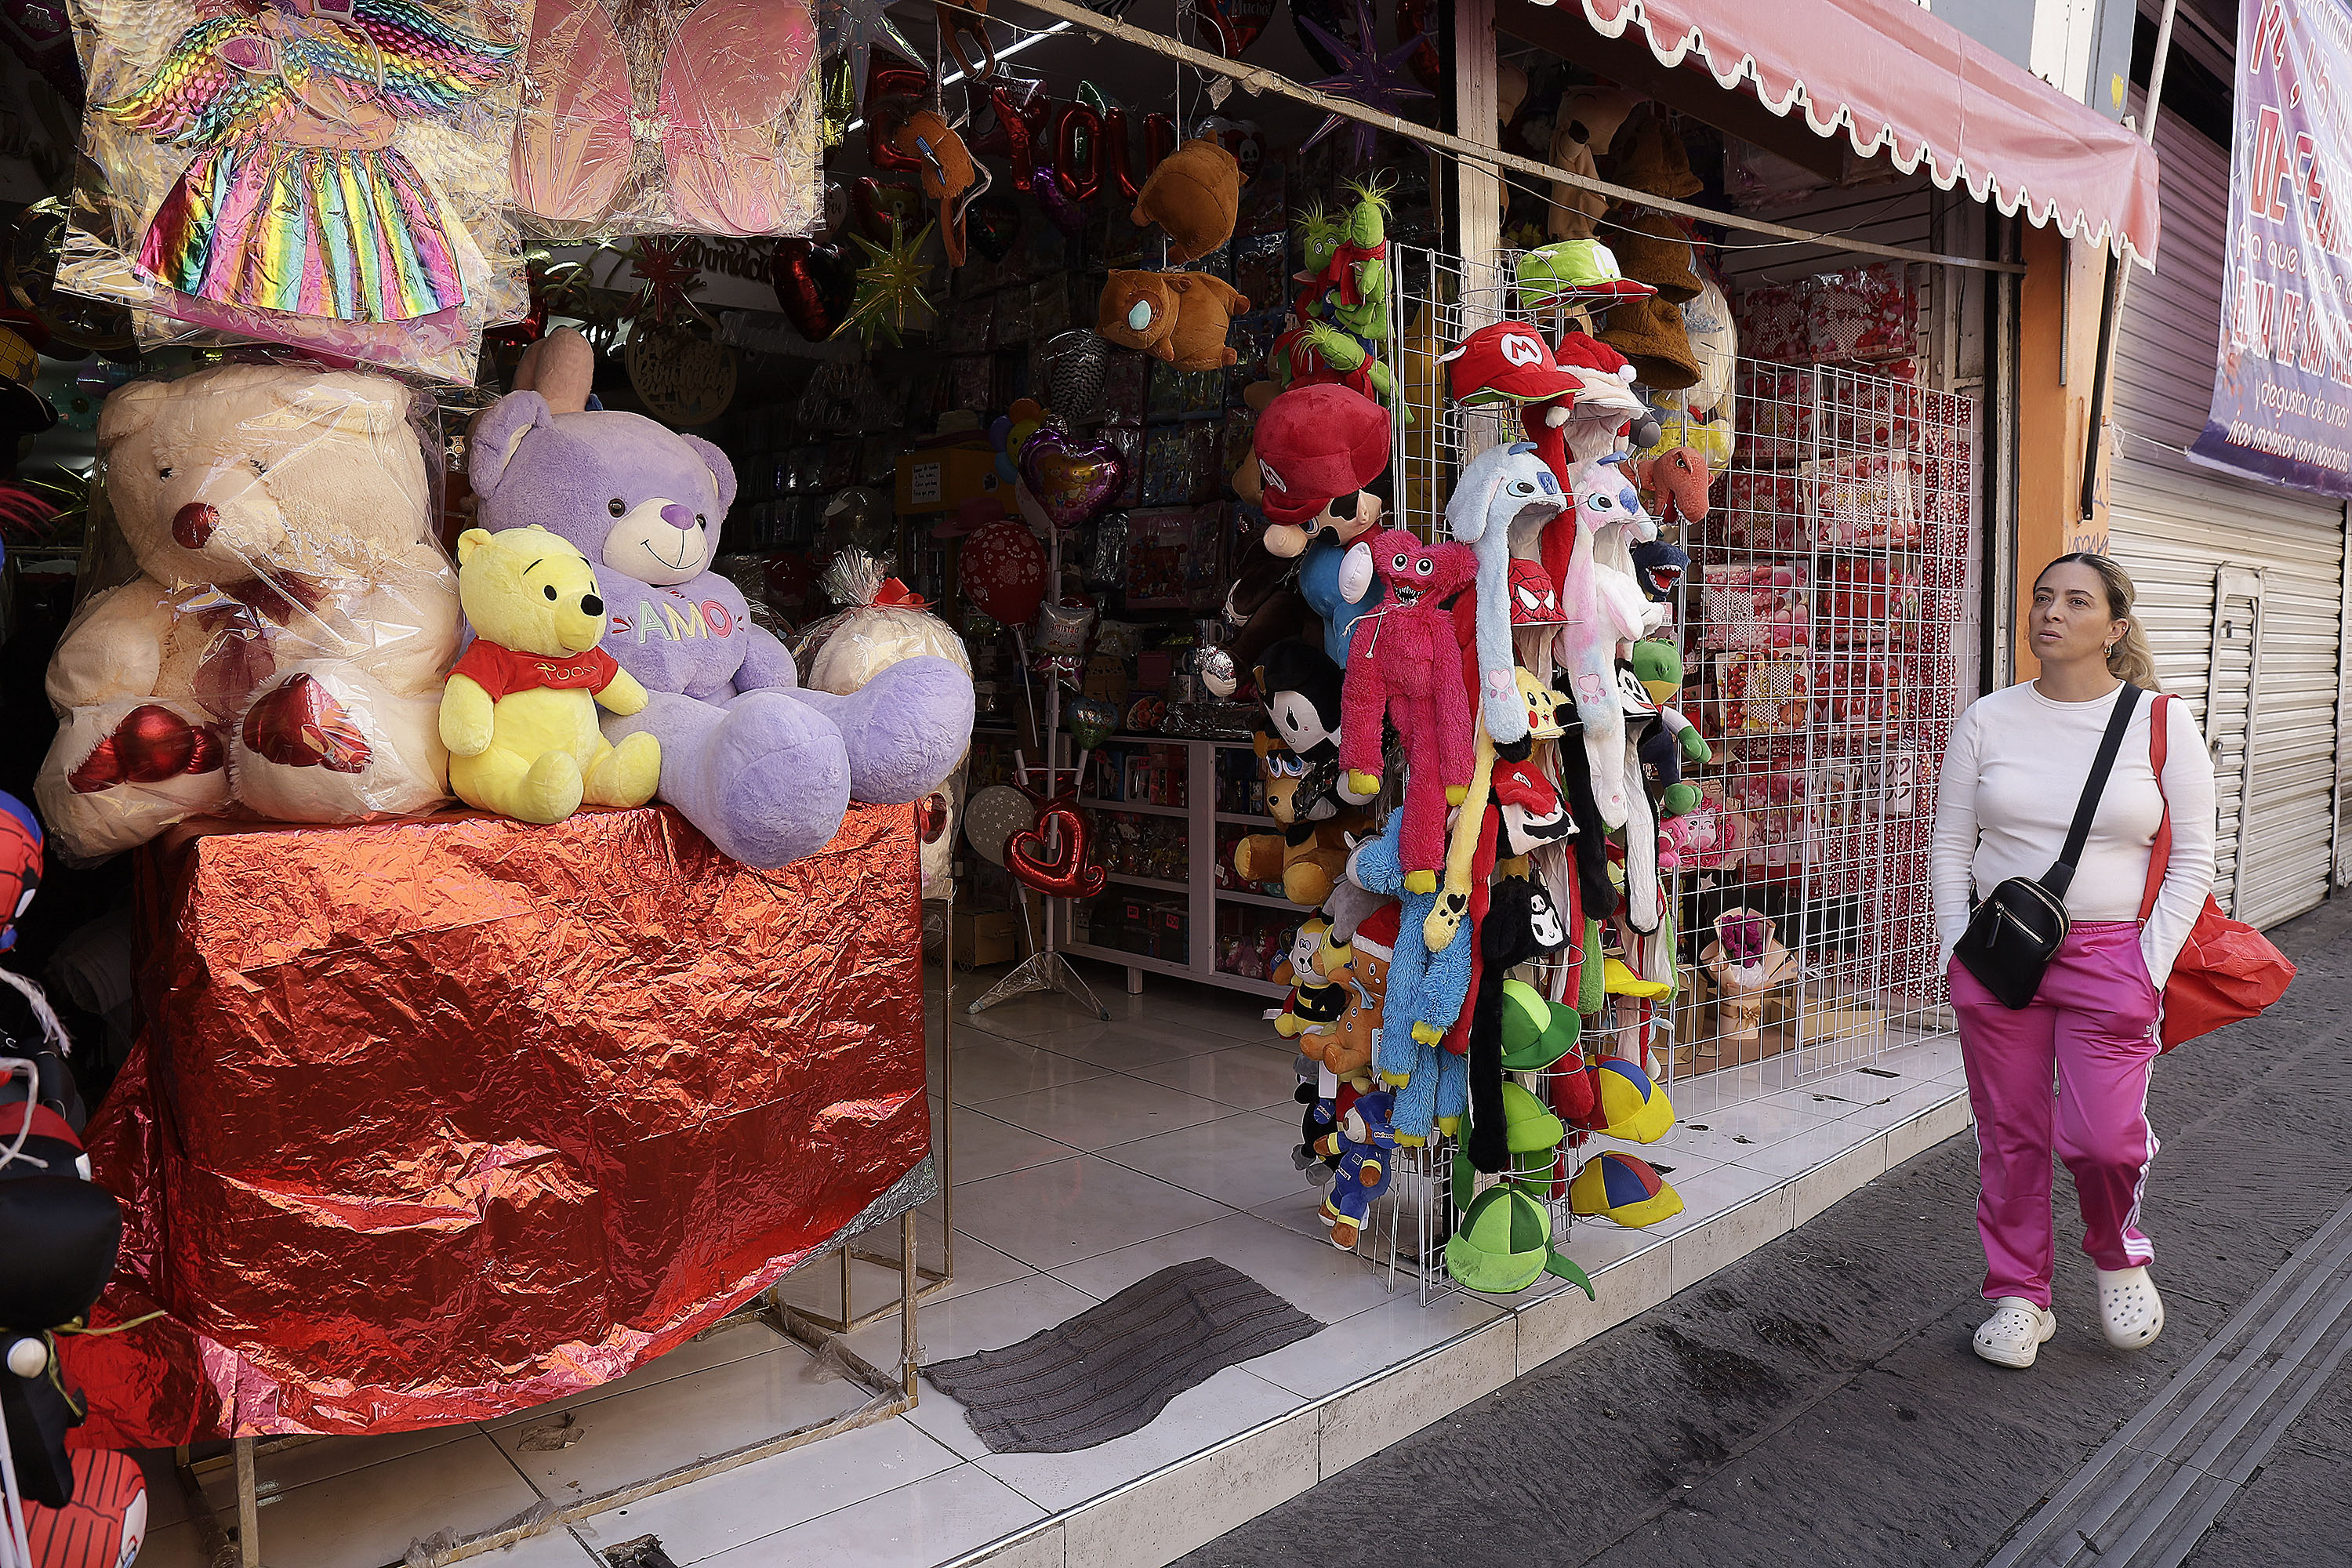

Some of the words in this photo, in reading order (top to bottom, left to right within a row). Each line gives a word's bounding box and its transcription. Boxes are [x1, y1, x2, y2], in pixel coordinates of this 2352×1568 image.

[2249, 104, 2288, 227] DE
[1595, 249, 1618, 278] L
[2267, 239, 2299, 276] que
[1510, 338, 1539, 360] M
[2276, 288, 2303, 368] DE
[2261, 372, 2312, 419] degustar
[2311, 388, 2326, 422] de
[2326, 401, 2350, 429] unos
[2224, 408, 2254, 448] ricos
[2295, 438, 2314, 464] con
[638, 598, 733, 644] AMO
